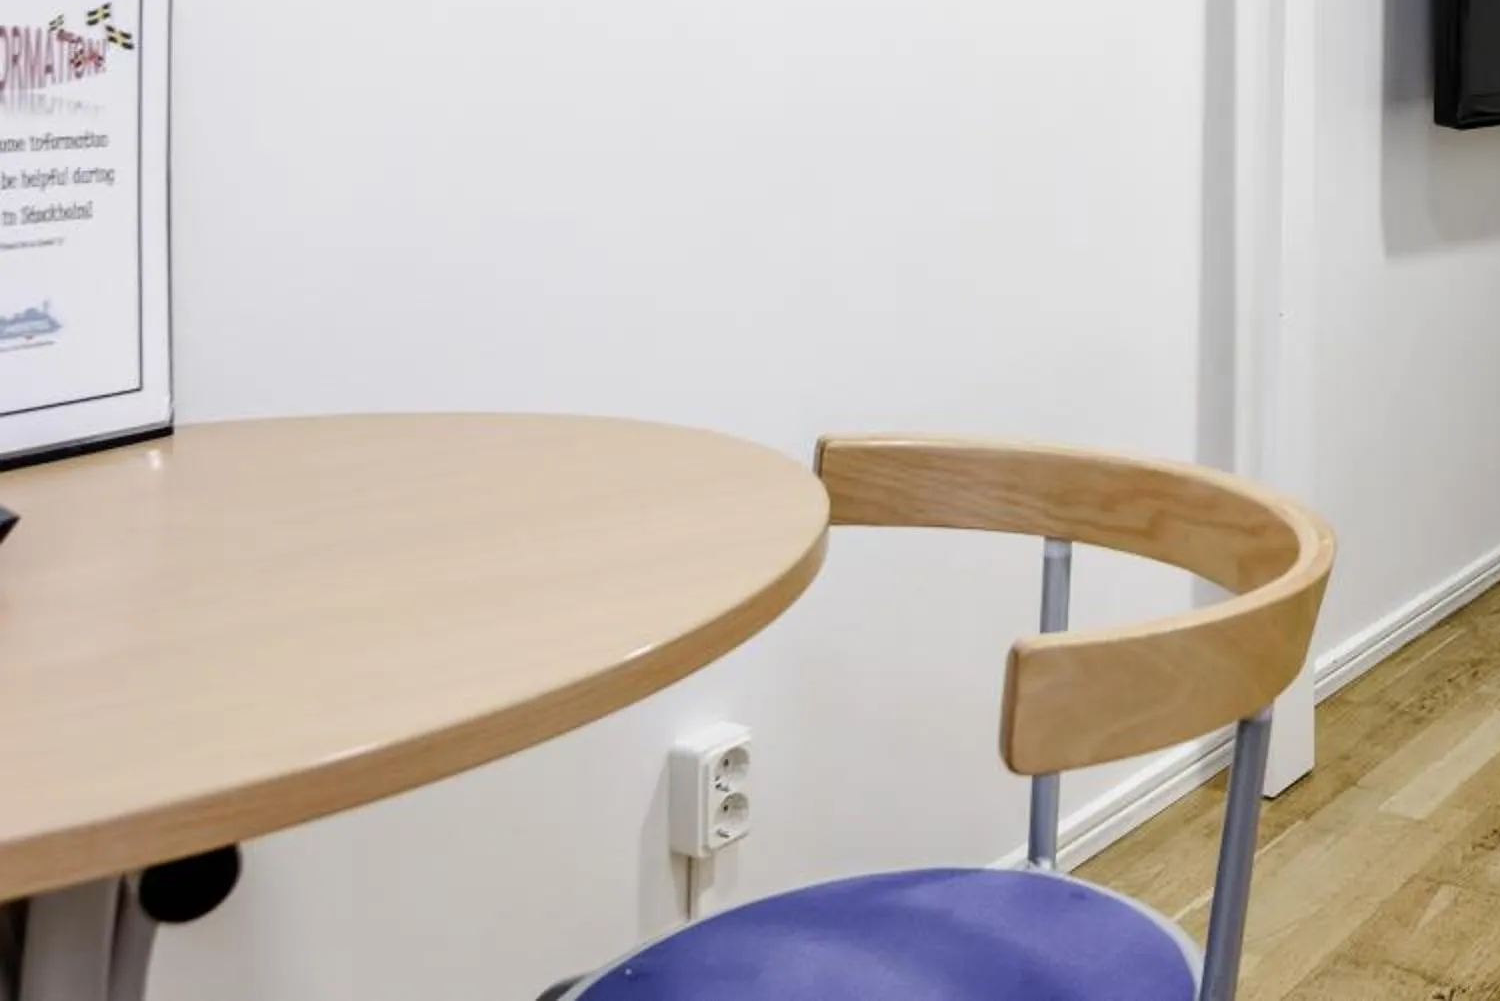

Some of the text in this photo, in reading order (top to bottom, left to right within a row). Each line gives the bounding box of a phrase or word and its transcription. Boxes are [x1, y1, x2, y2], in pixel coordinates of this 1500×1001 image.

[30, 132, 109, 151] information
[1, 167, 115, 191] be helpful during
